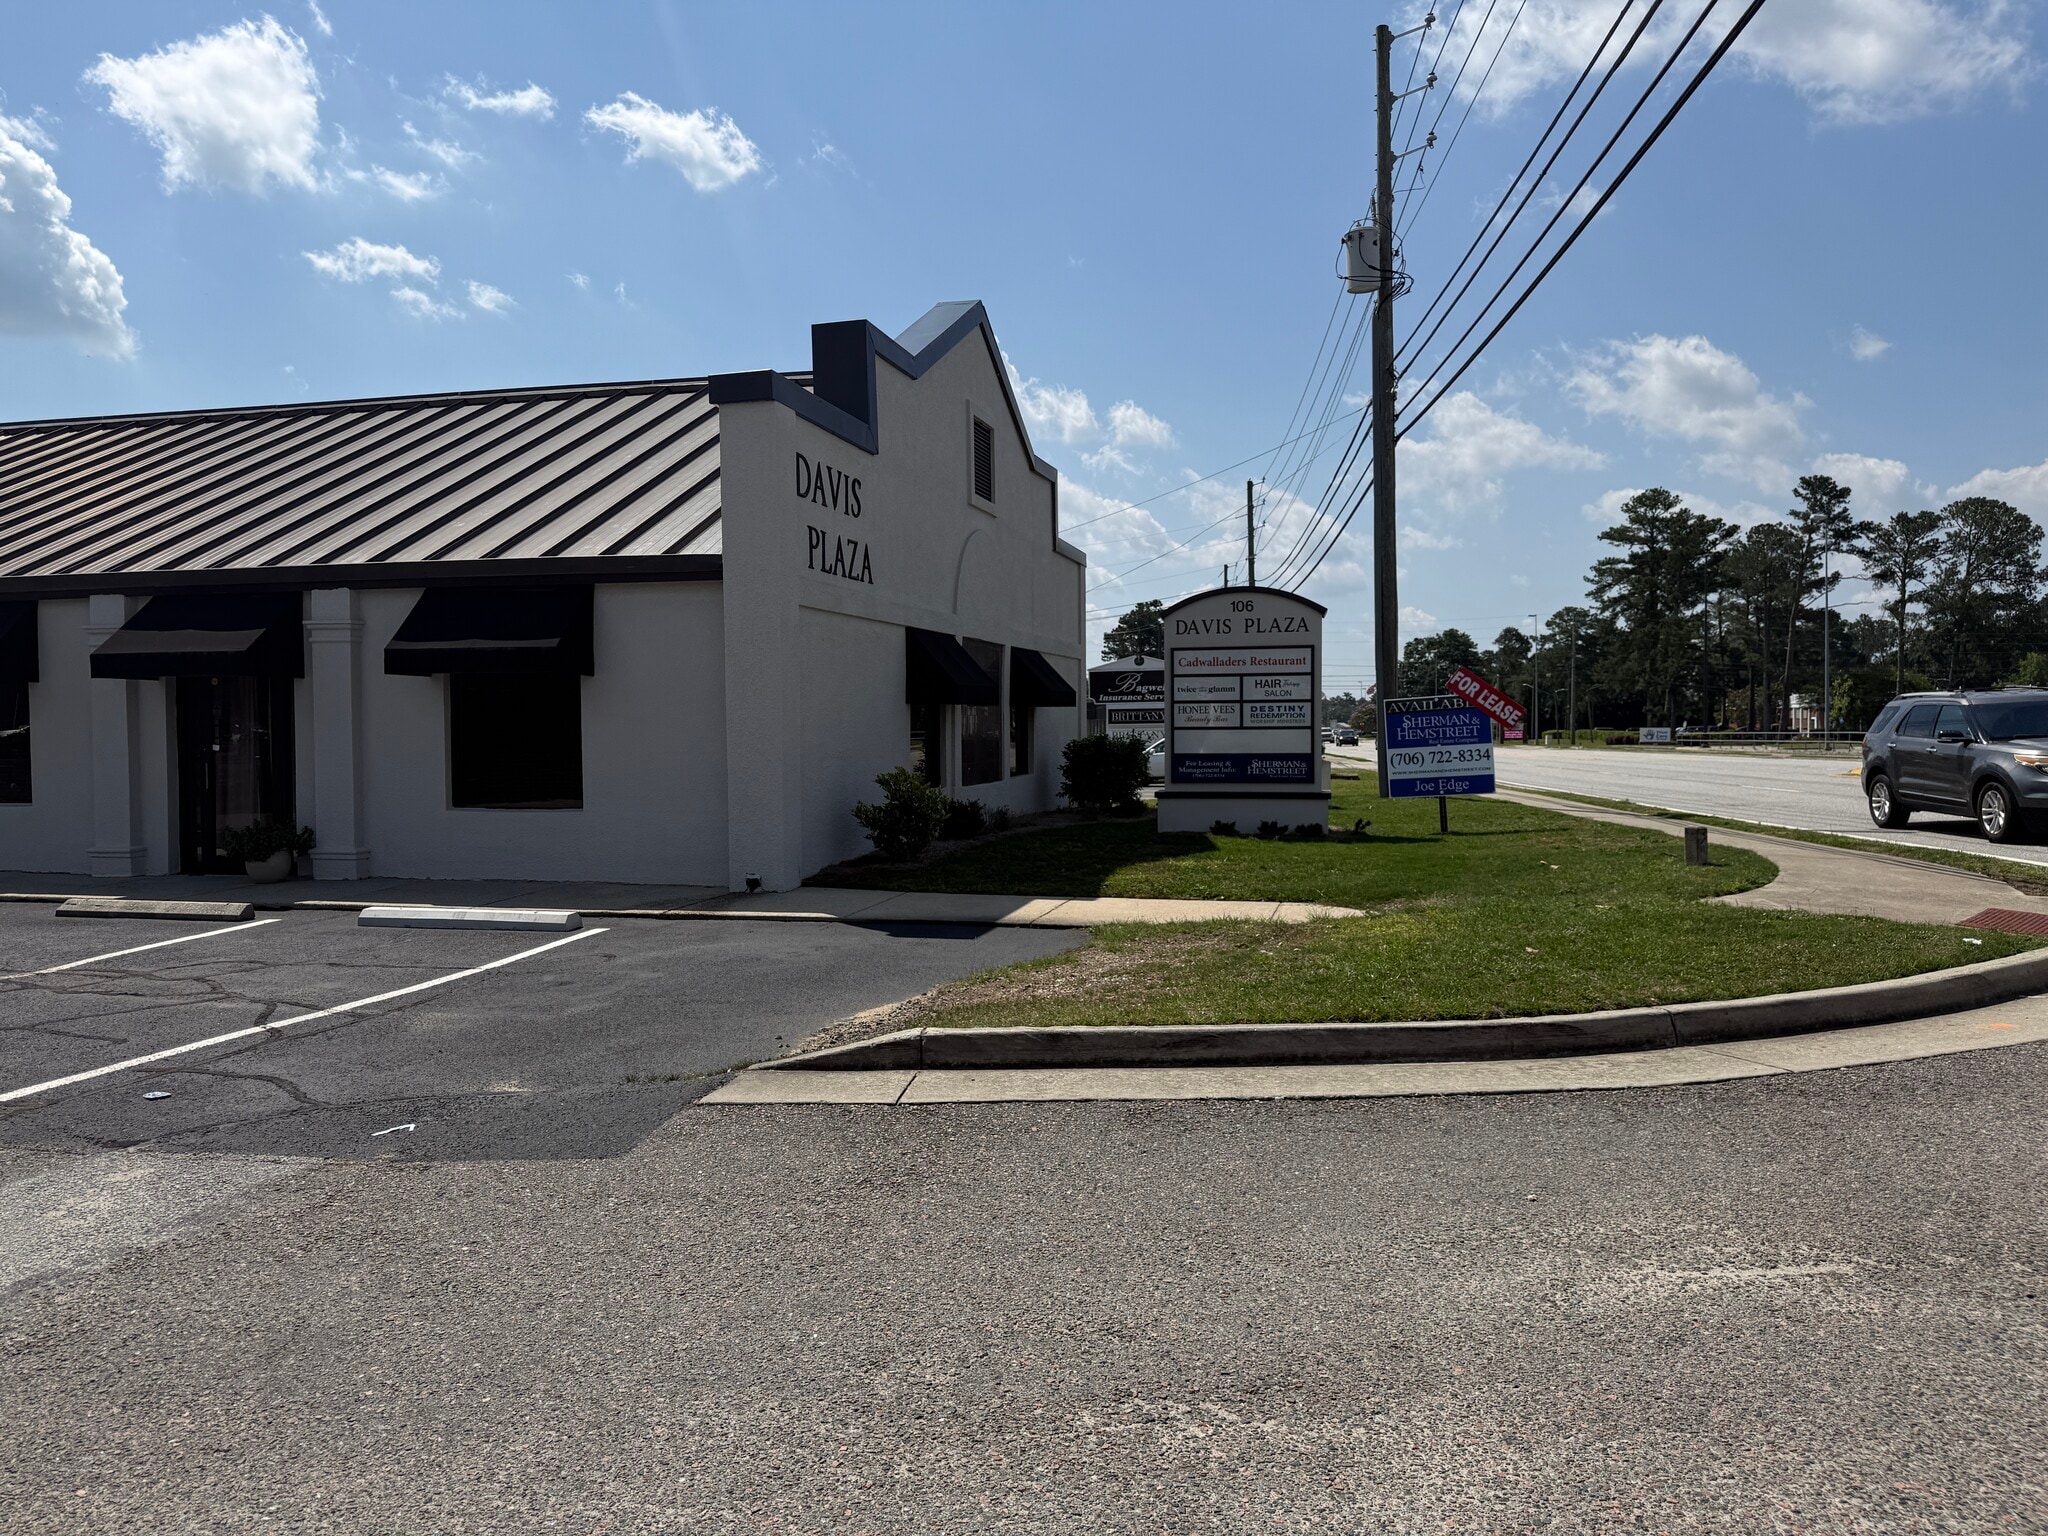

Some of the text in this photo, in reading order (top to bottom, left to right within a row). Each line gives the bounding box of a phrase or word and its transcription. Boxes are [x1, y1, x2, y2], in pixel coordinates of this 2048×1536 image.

[796, 451, 862, 518] DAVIS
[806, 524, 874, 585] PLAZA
[1230, 600, 1254, 613] 106
[1175, 616, 1310, 635] DAVIS PLAZA
[1178, 655, 1307, 668] Cadwalladers Restaurant
[1177, 685, 1197, 693] twice
[1208, 685, 1236, 694] glamm
[1254, 679, 1281, 689] HAIR
[1264, 689, 1292, 697] SALON
[1450, 671, 1522, 726] FOR LEASE
[1177, 705, 1236, 715] HONEE VEES
[1250, 705, 1305, 713] DESTINY
[1387, 698, 1476, 713] AVAILABL
[1402, 713, 1480, 729] SHERMAN &
[1396, 725, 1480, 740] HEMSTREET
[1198, 760, 1224, 768] Leasing
[1251, 759, 1300, 769] SHERMAN
[1390, 748, 1491, 769] (706) 722-8334
[1247, 765, 1308, 775] HEMSTREET
[1414, 779, 1470, 792] Joe Edge
